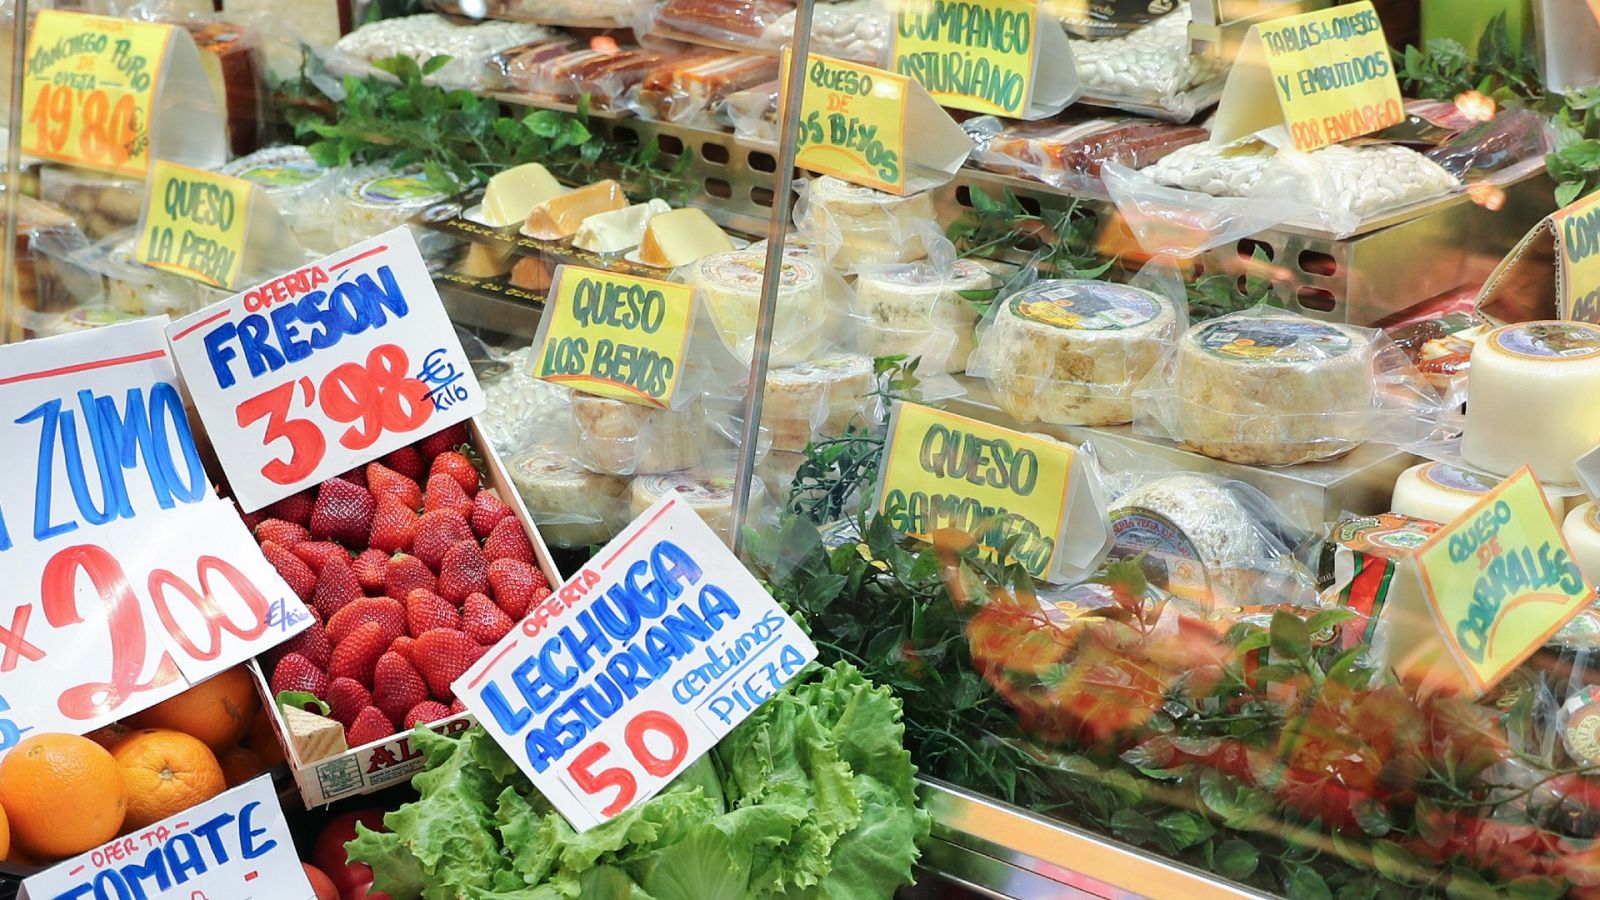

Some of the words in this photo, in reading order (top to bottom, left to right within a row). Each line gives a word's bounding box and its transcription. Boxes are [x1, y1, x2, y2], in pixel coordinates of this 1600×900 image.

[898, 0, 1030, 55] COMPANGO
[1262, 22, 1321, 55] TABLAS
[111, 39, 151, 92] PURO
[810, 60, 873, 96] QUESO
[897, 51, 1024, 112] ASTURIANO
[1277, 74, 1291, 102] Y
[1297, 51, 1389, 96] EMBUTIDOS
[827, 92, 853, 113] DE
[1292, 118, 1323, 151] POR
[1324, 98, 1401, 144] ENCARGO
[796, 110, 824, 154] OS
[828, 112, 899, 184] BEYOS
[165, 177, 234, 232] QUESO
[147, 225, 173, 263] LA
[176, 229, 236, 286] PERAL
[244, 266, 329, 313] OFERTA
[572, 277, 666, 334] QUESO
[541, 336, 589, 376] LOS
[14, 382, 206, 541] ZUMO
[919, 423, 1039, 496] QUESO
[1449, 500, 1510, 564] QUESO
[1476, 535, 1503, 571] DE
[521, 568, 601, 638] OFERTA
[1456, 540, 1584, 664] CABRALES
[480, 540, 703, 736] LECHUGA
[524, 584, 741, 775] ASTURIANA
[567, 710, 689, 818] 50
